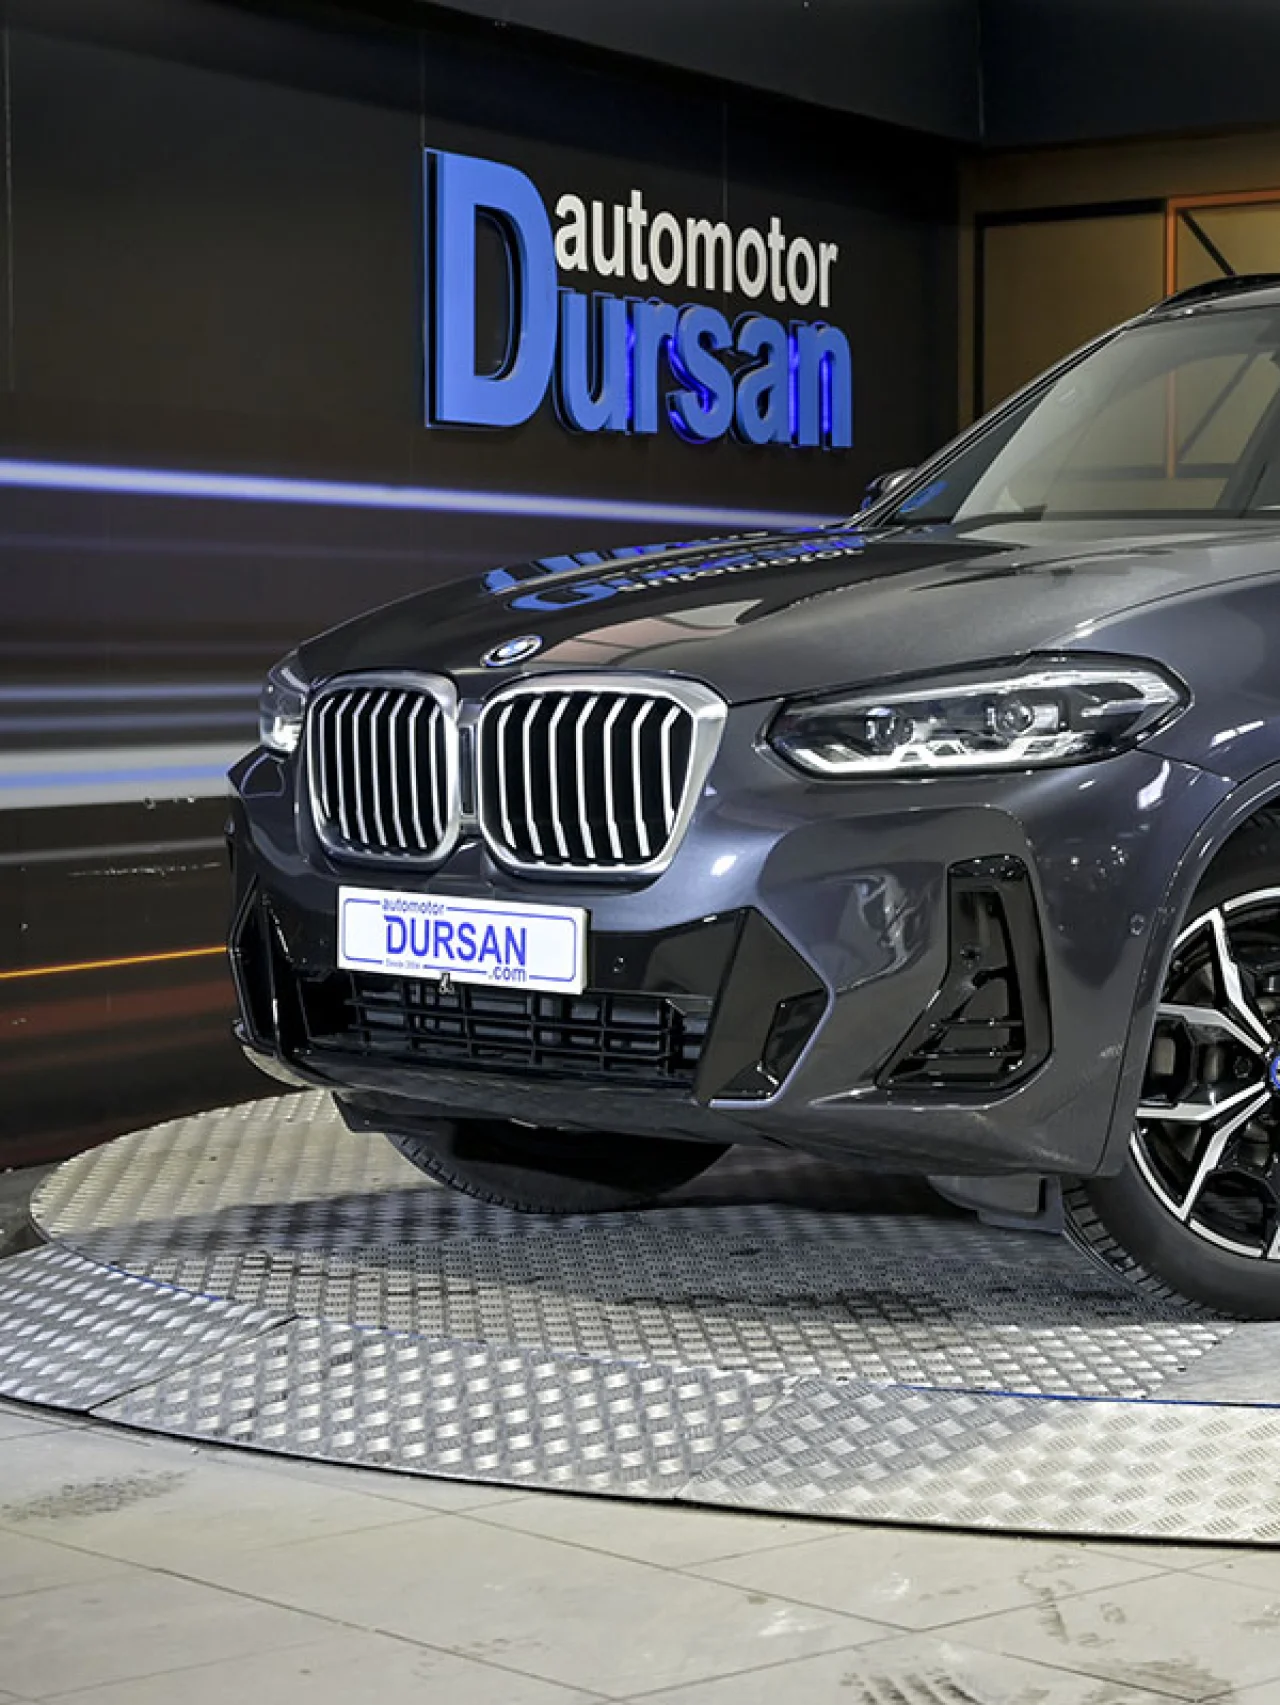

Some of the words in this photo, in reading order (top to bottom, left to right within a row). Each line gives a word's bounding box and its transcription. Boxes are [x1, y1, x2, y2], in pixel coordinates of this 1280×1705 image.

[554, 189, 838, 307] automotor
[425, 147, 853, 450] Dursan
[382, 898, 445, 916] automotor
[384, 915, 528, 967] DURSAN
[488, 966, 528, 983] .com
